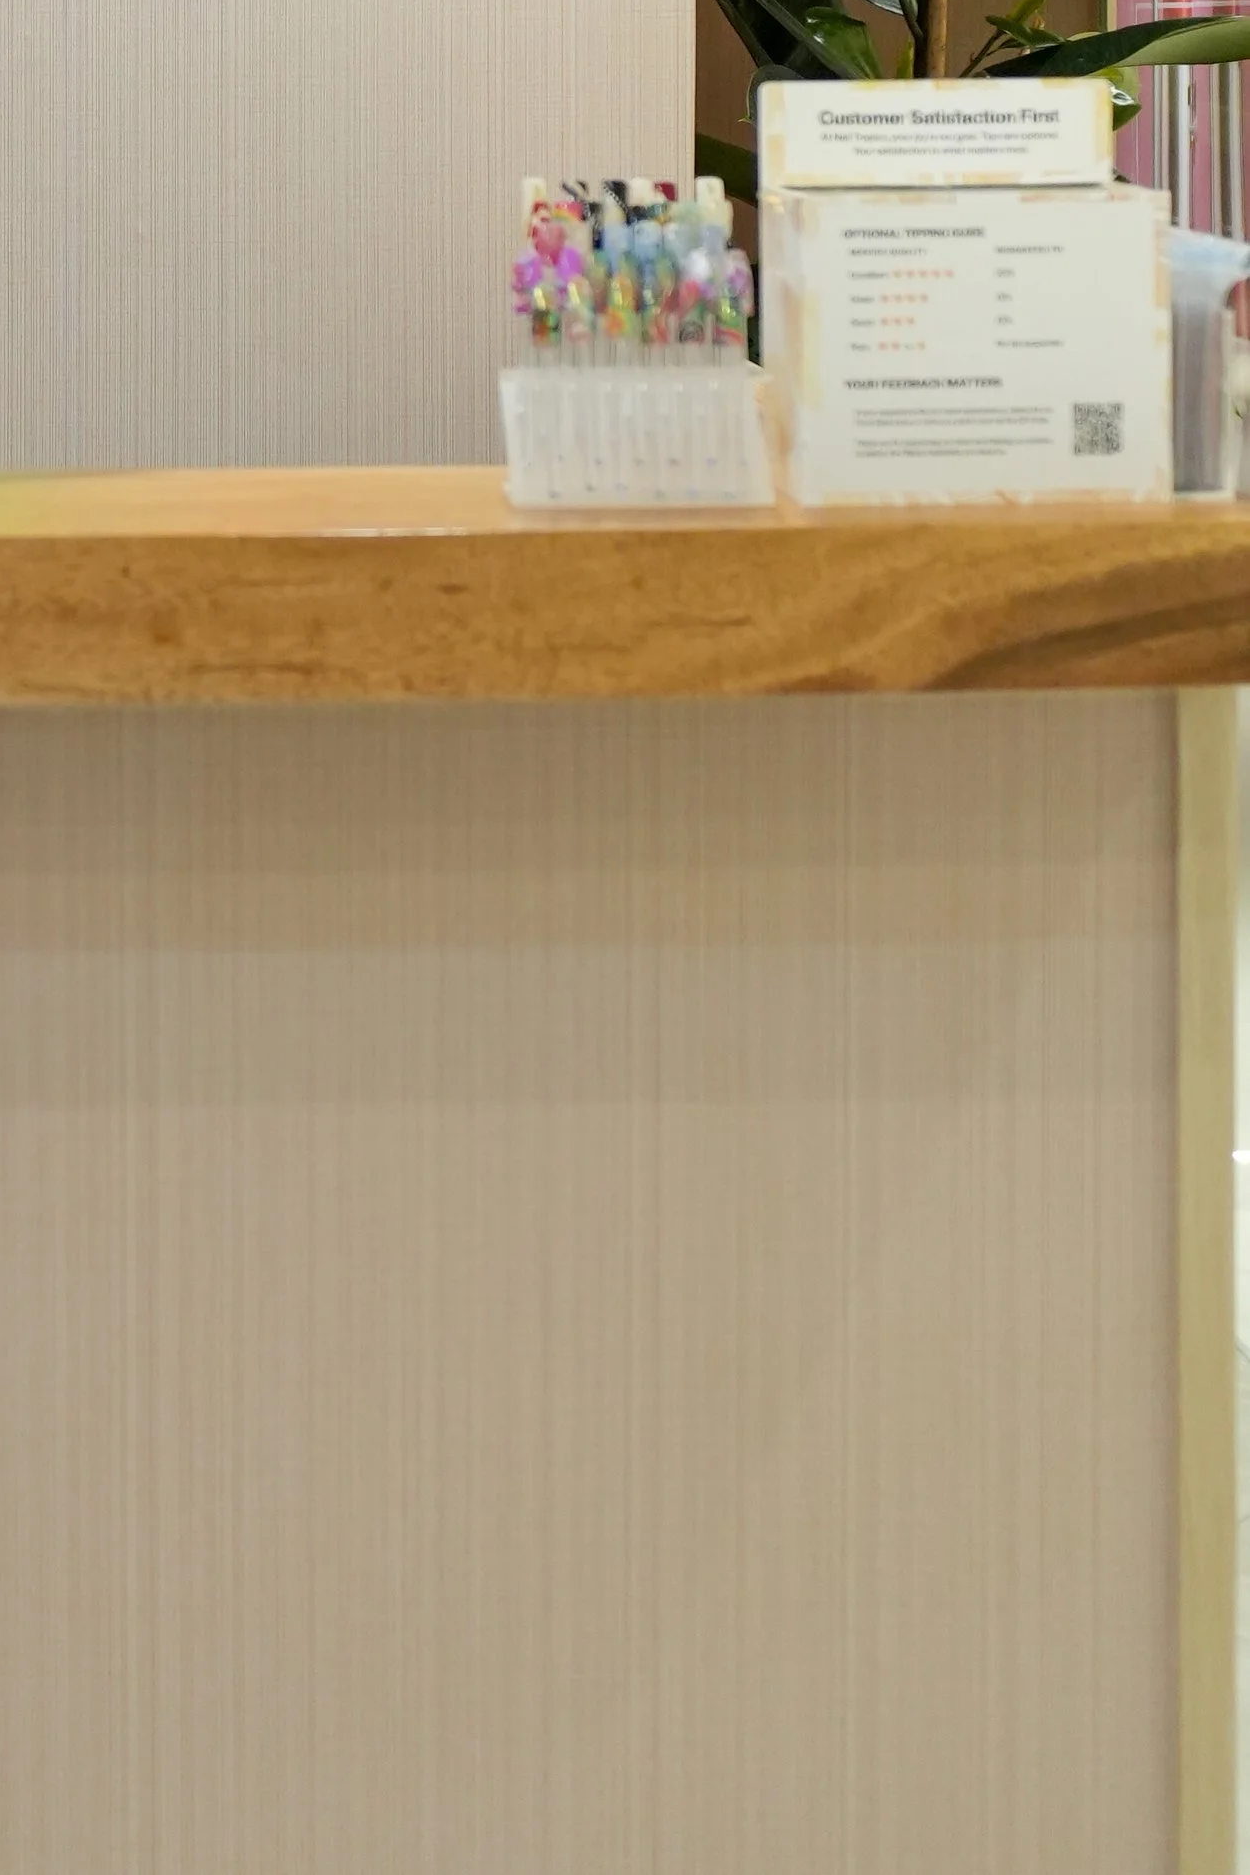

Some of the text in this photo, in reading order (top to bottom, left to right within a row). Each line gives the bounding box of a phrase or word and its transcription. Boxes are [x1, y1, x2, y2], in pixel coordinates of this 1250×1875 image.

[819, 108, 1060, 126] Customer Satisfaction First
